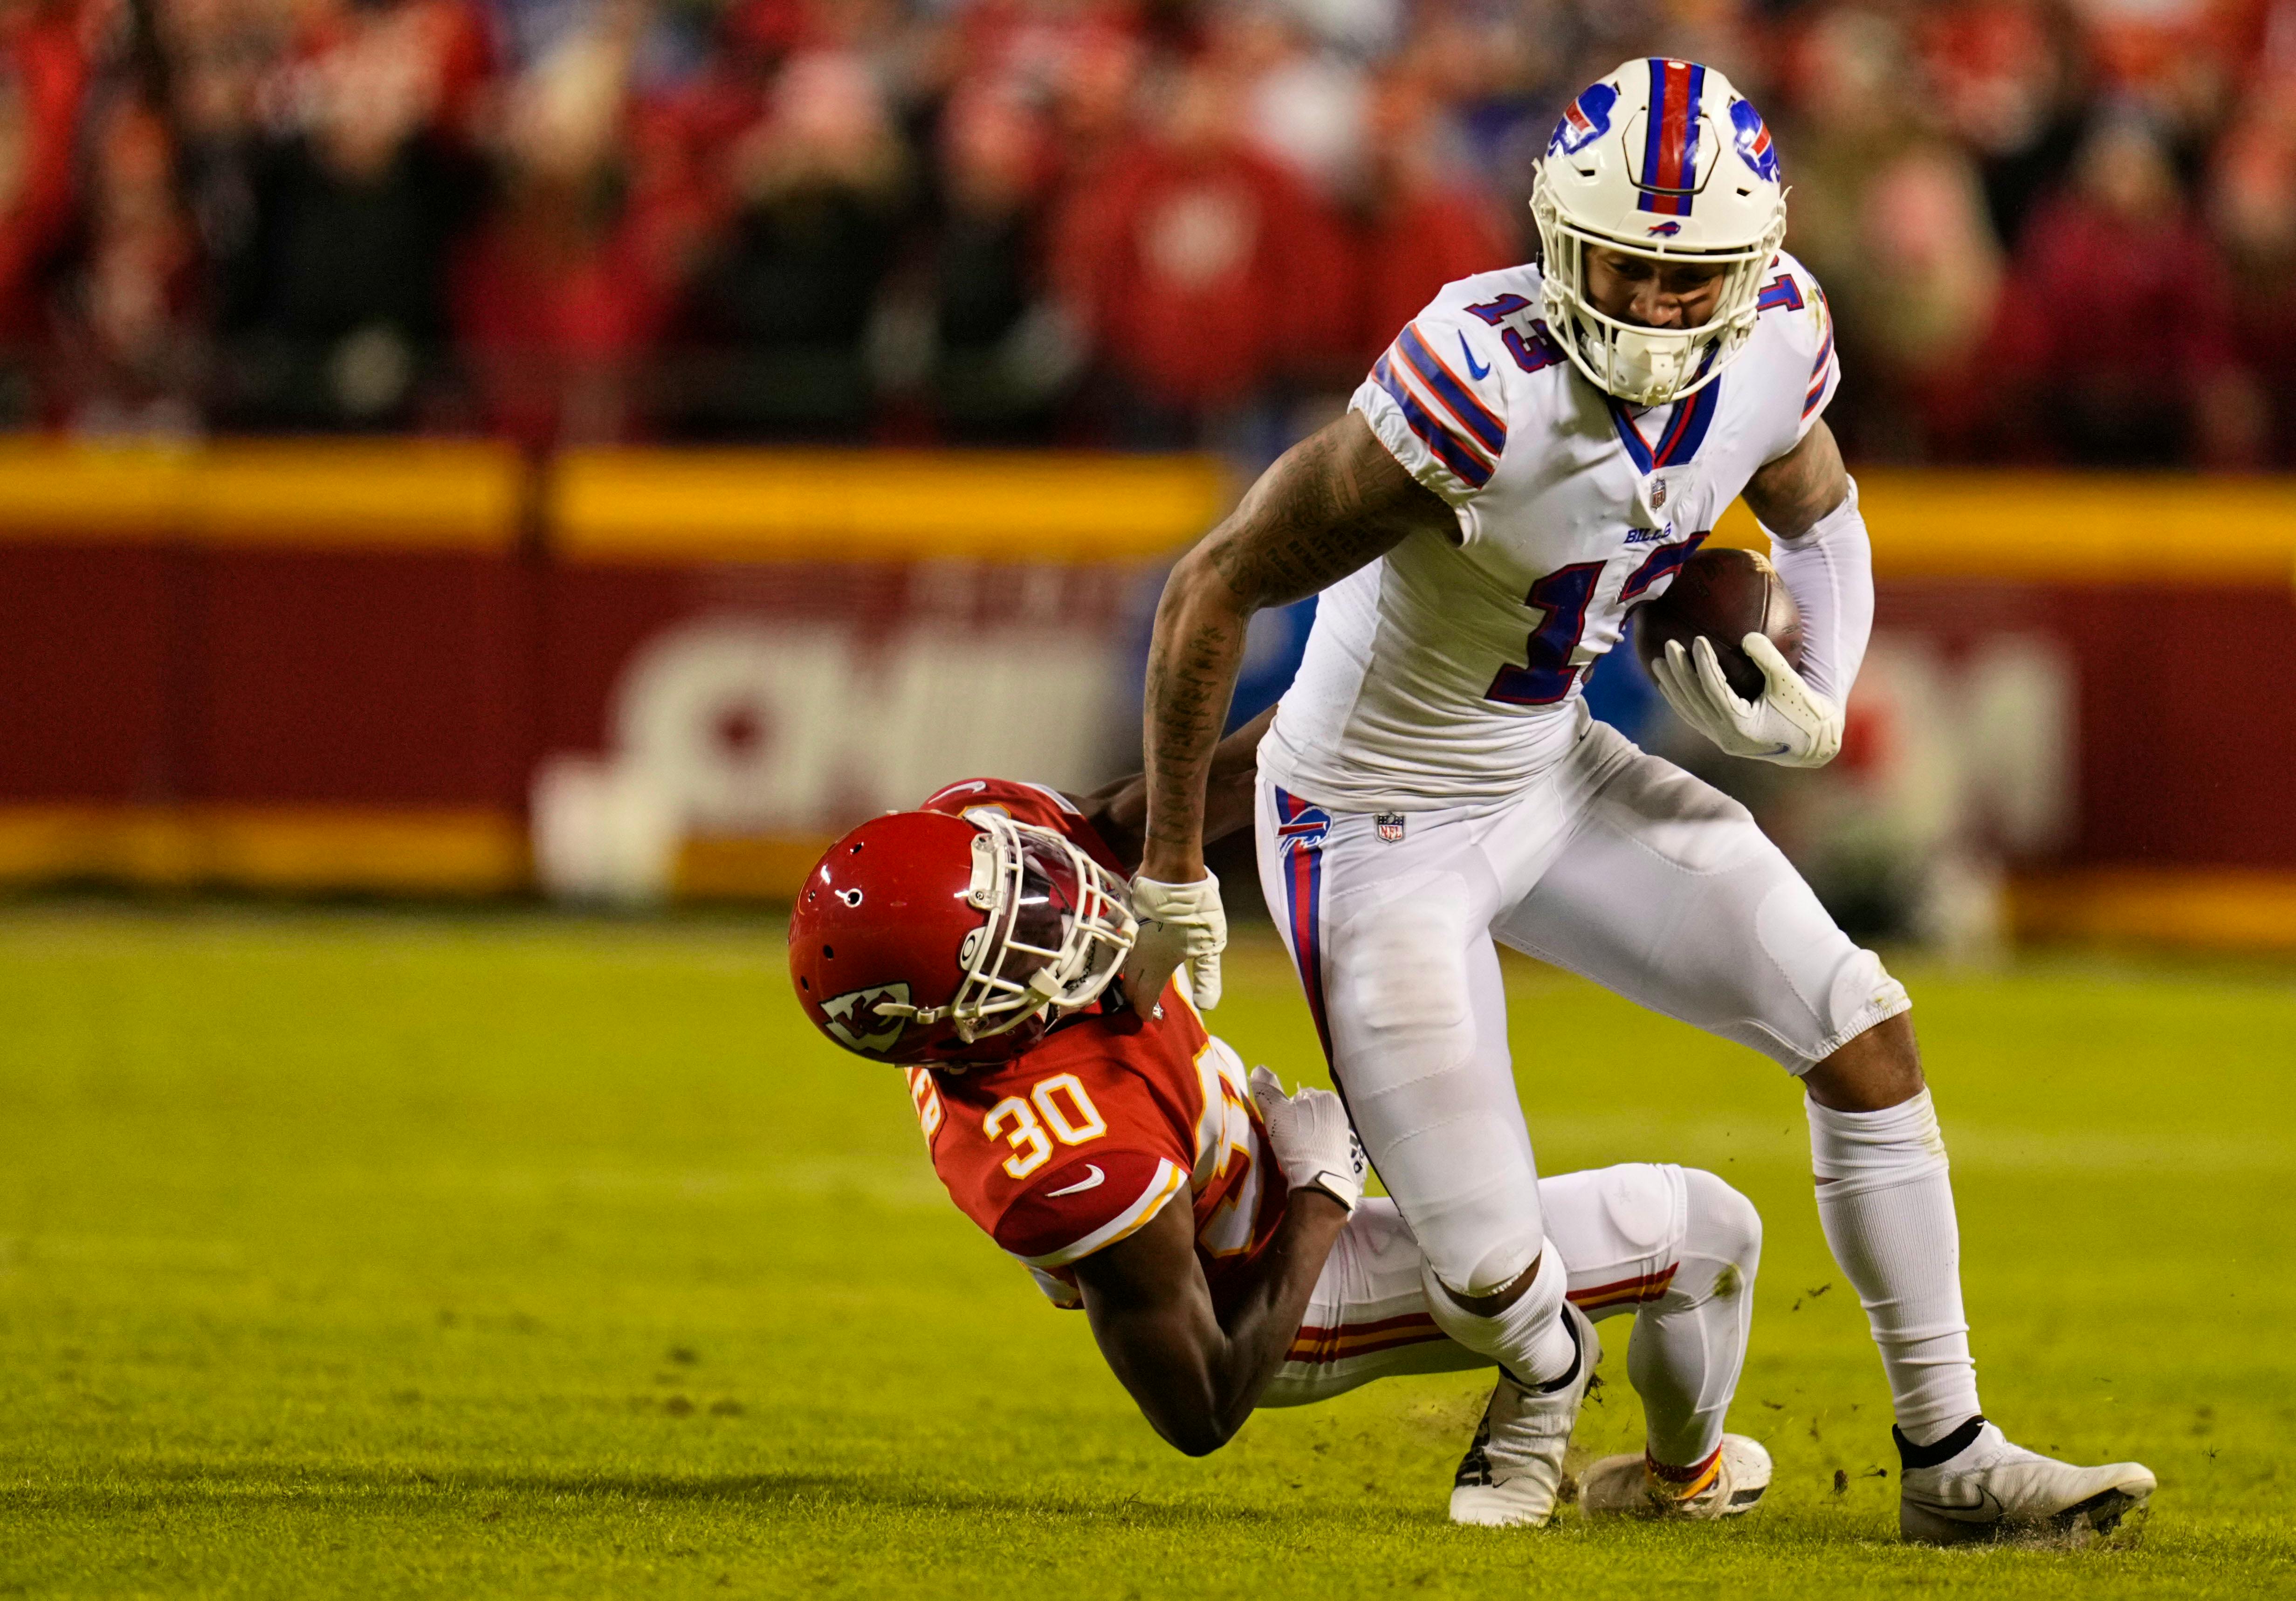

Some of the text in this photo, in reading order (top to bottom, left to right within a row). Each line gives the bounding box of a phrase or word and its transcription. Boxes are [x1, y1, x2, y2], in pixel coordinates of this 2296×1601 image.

[1463, 293, 1569, 374] 13
[1380, 825, 1402, 839] NFL
[983, 1072, 1107, 1180] 30
